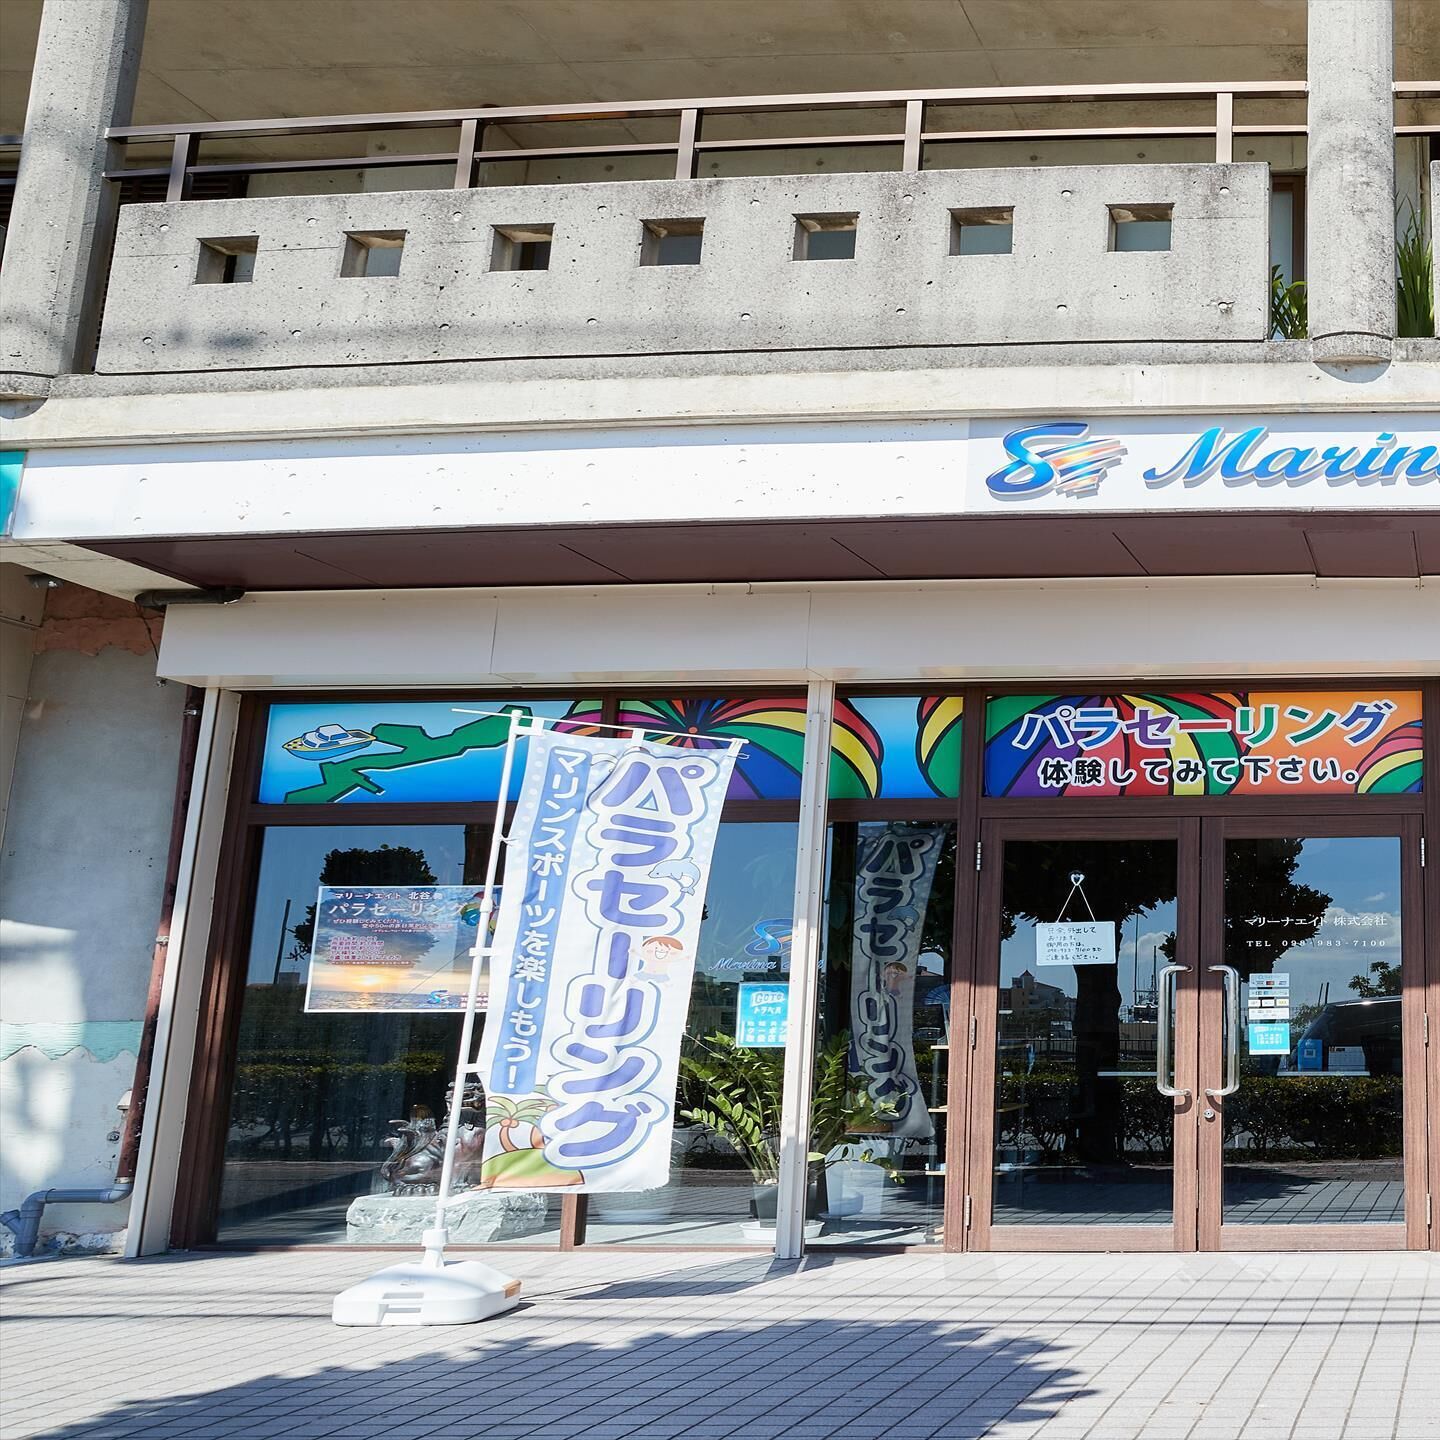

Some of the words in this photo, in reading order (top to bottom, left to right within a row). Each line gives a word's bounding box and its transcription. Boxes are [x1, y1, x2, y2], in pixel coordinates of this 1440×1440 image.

[1012, 700, 1398, 750] パラセーリング
[1037, 757, 1360, 786] 体験してみて下さい。
[329, 901, 467, 916] パラセーリング
[1245, 917, 1328, 927] マリーナエイト
[1334, 916, 1388, 926] 株式会社
[555, 760, 702, 1158] パラセーリング
[708, 957, 777, 971] Marina
[754, 1006, 782, 1014] トラベル
